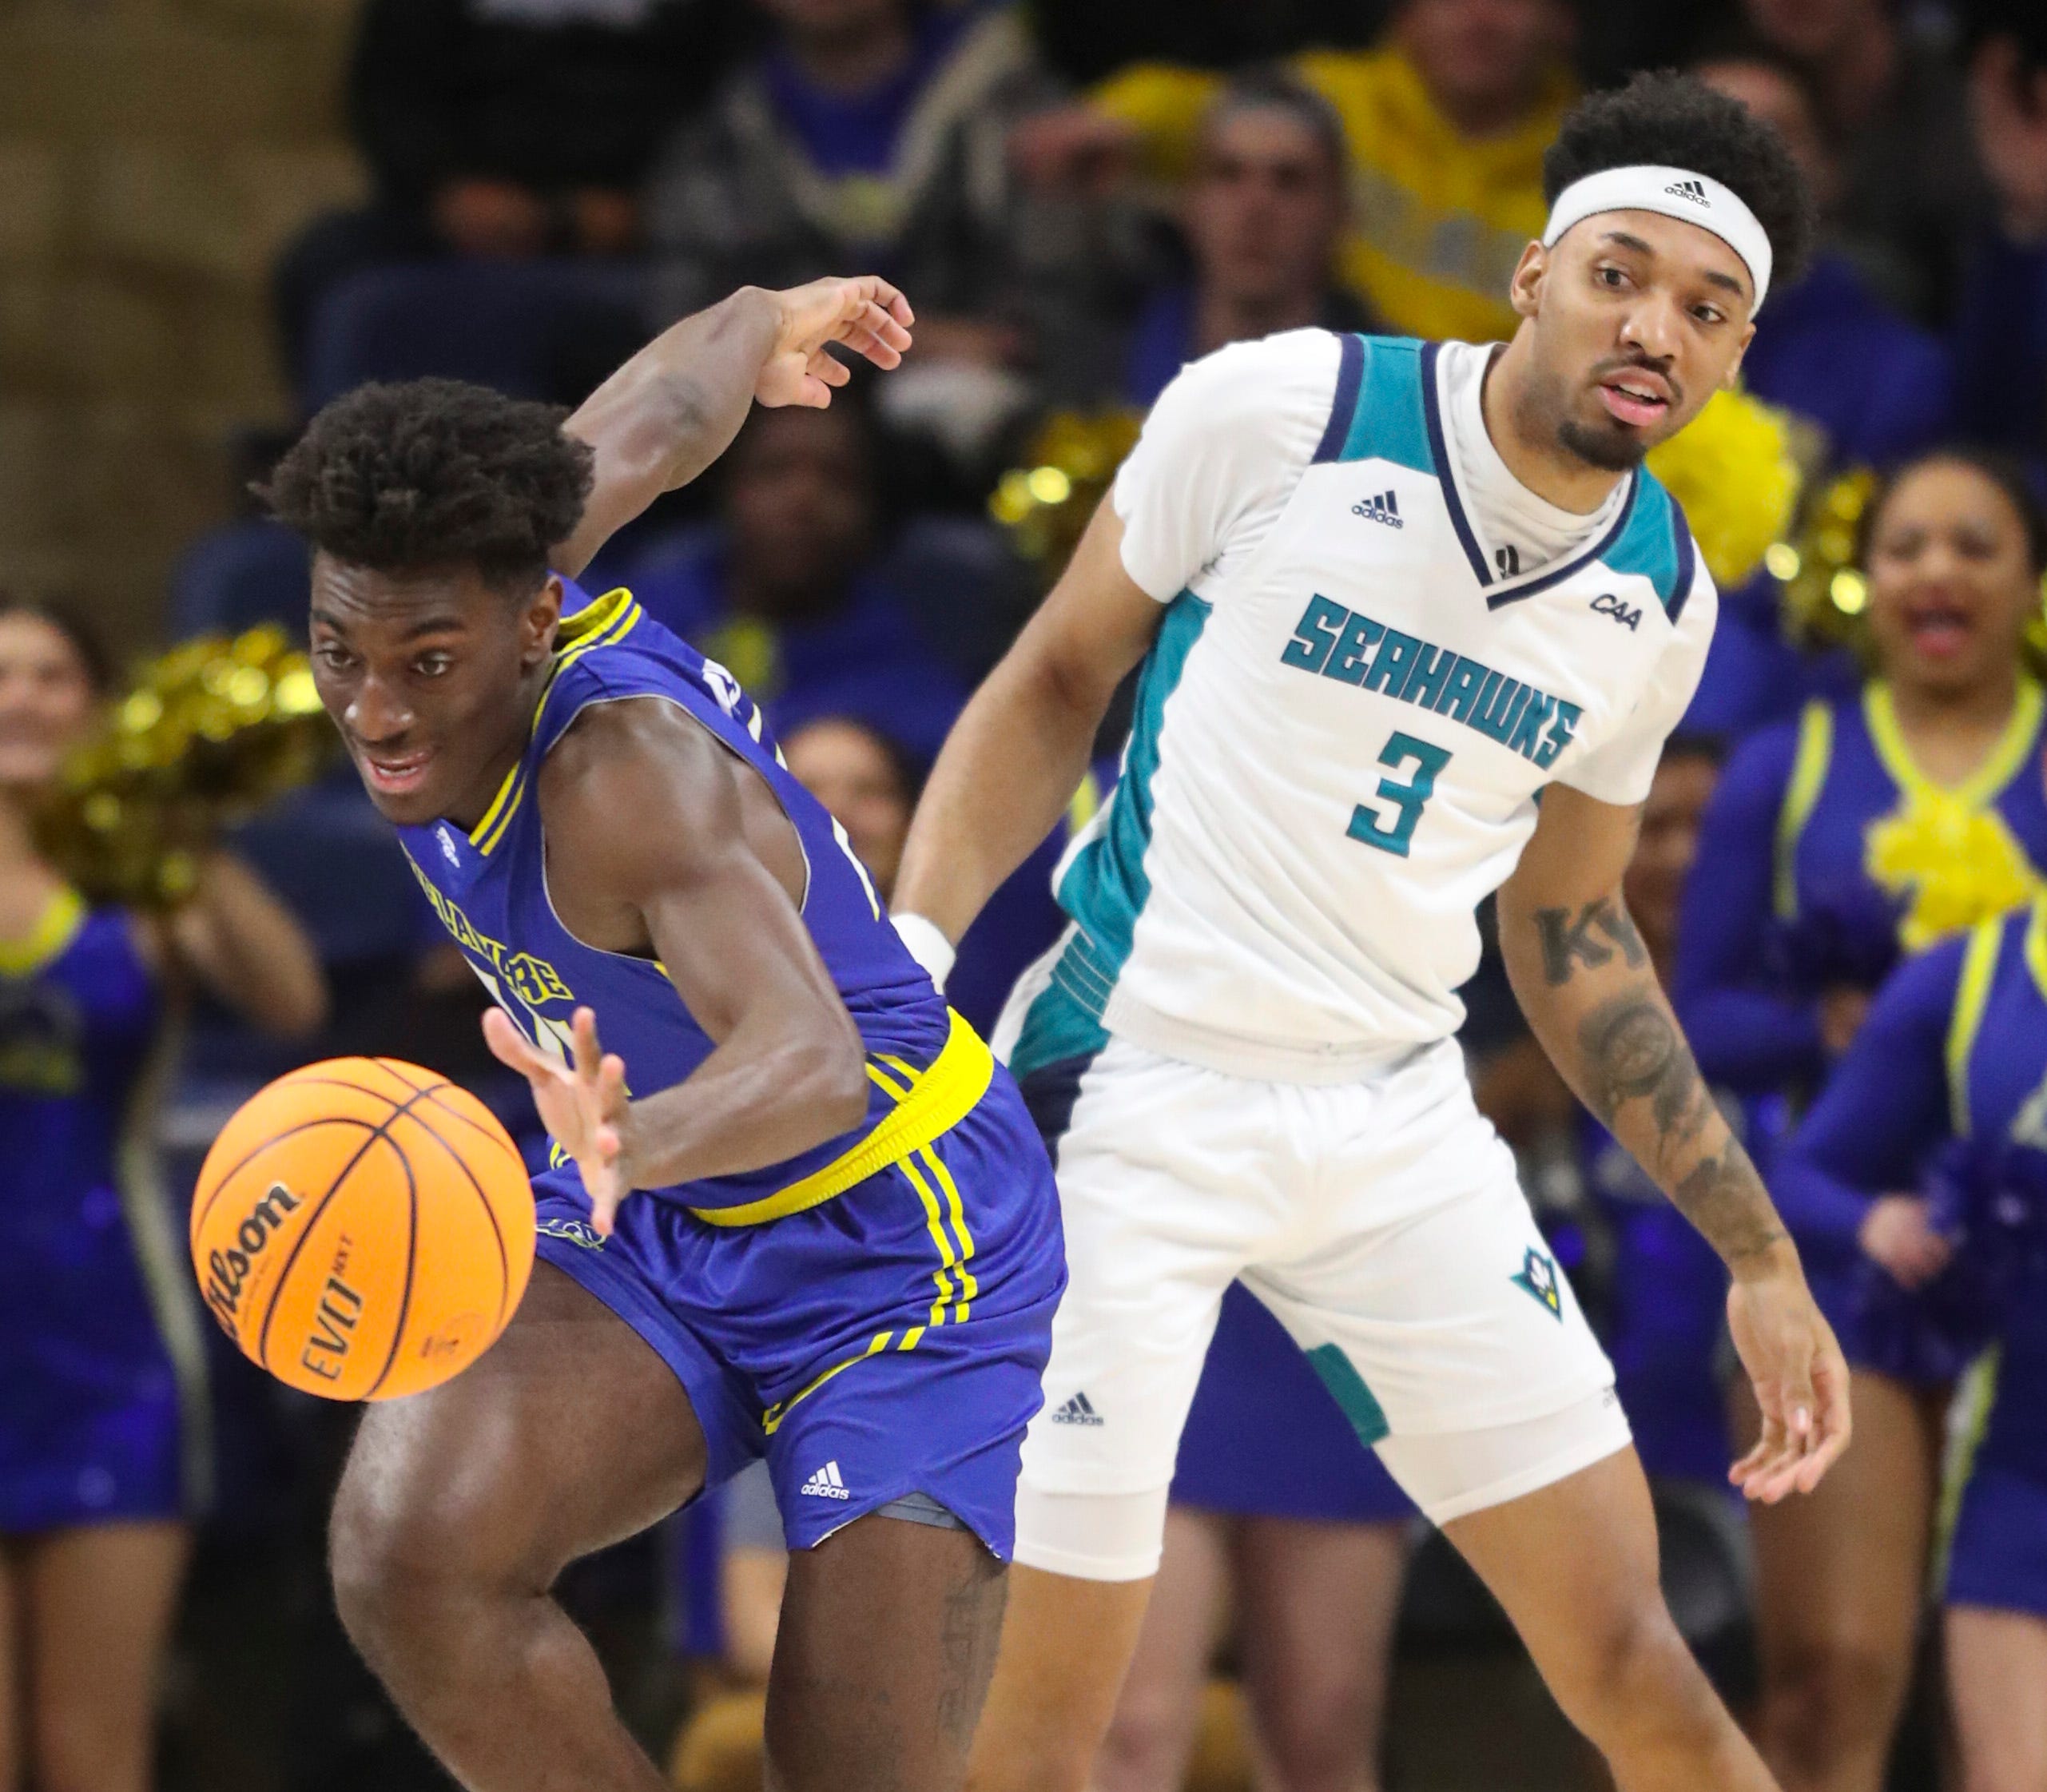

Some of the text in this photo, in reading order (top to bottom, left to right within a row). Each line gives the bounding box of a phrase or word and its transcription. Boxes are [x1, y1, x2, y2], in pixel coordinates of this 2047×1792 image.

[1664, 185, 1711, 209] adidas
[1351, 505, 1404, 530] adidas
[1590, 594, 1643, 632] CAA
[1281, 593, 1585, 772] SEAHAWKS
[1345, 730, 1453, 859] 3
[801, 1483, 850, 1500] adidas
